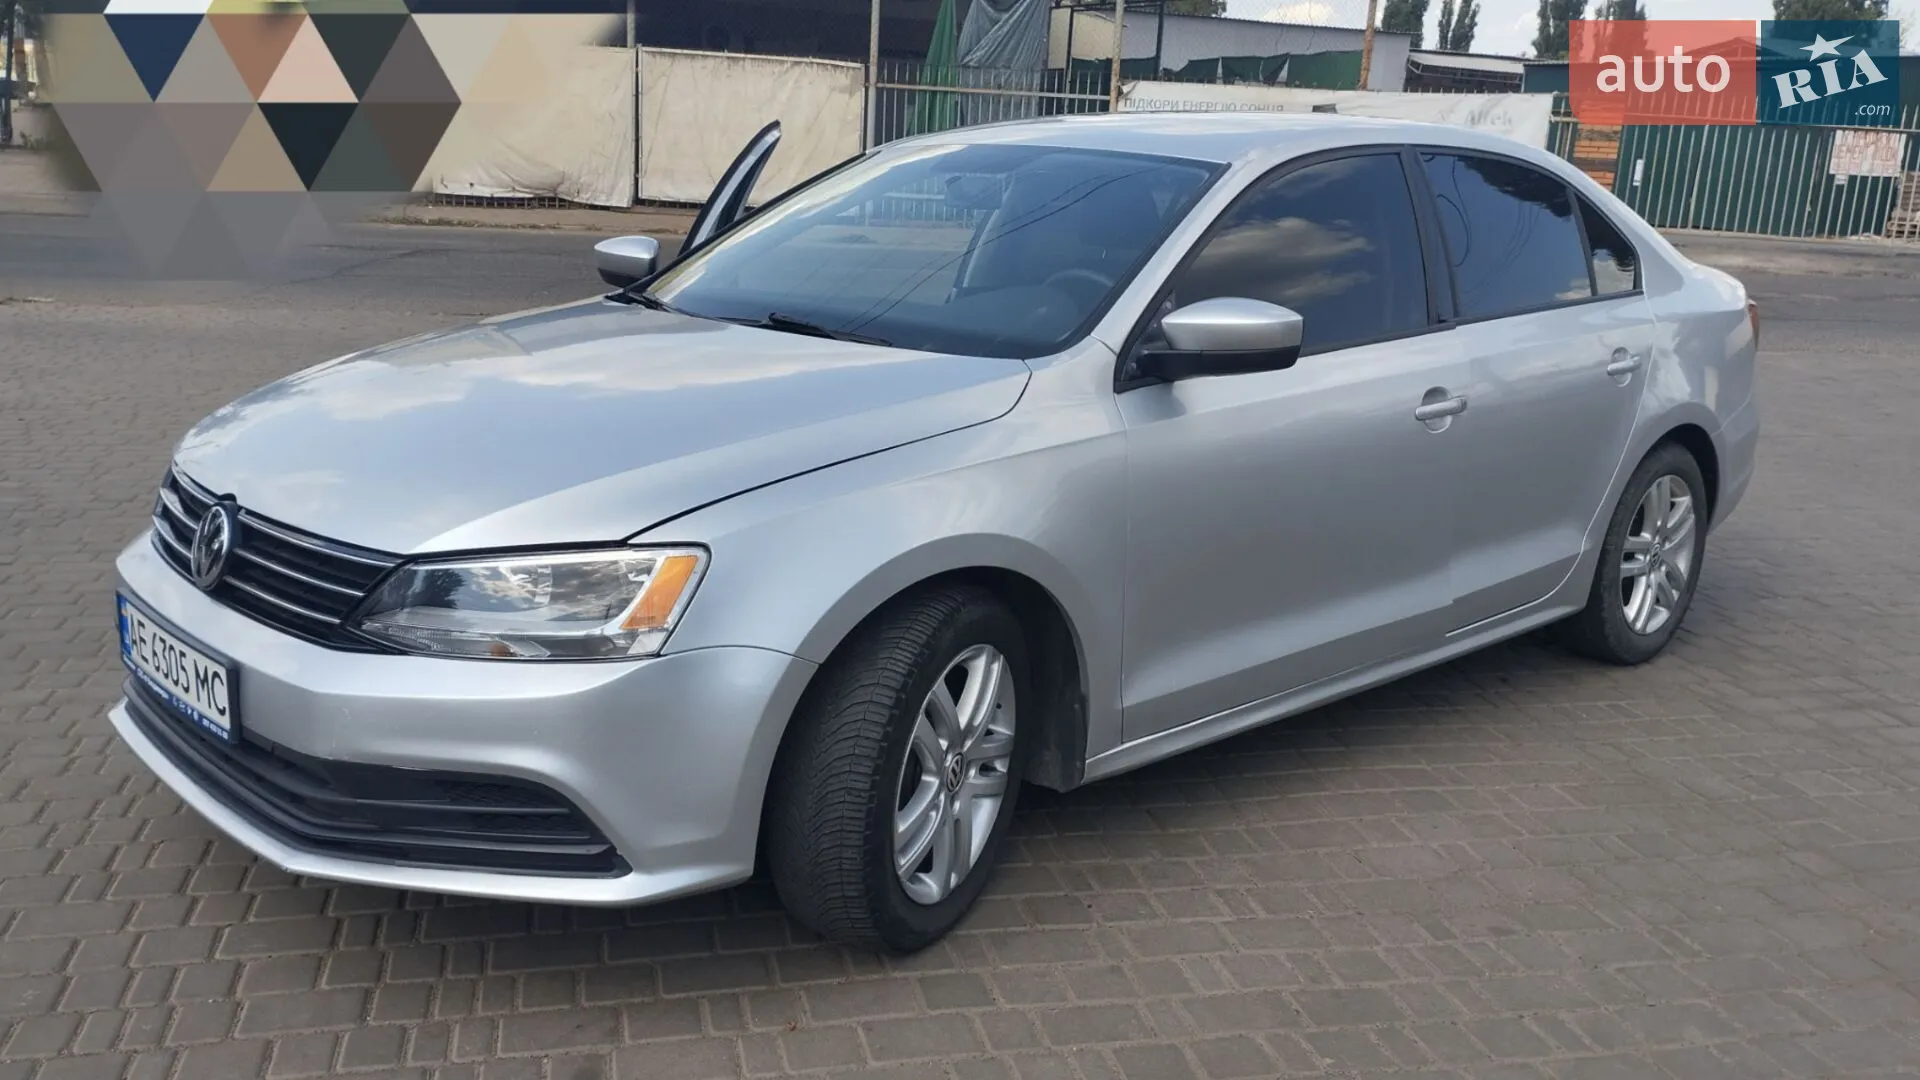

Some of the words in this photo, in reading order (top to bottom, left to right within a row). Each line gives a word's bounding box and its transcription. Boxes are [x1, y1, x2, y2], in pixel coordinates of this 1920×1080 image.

[1123, 97, 1180, 111] ПІДКОРИ
[130, 614, 149, 665] AE
[152, 632, 190, 694] 6305
[194, 659, 226, 717] MC
